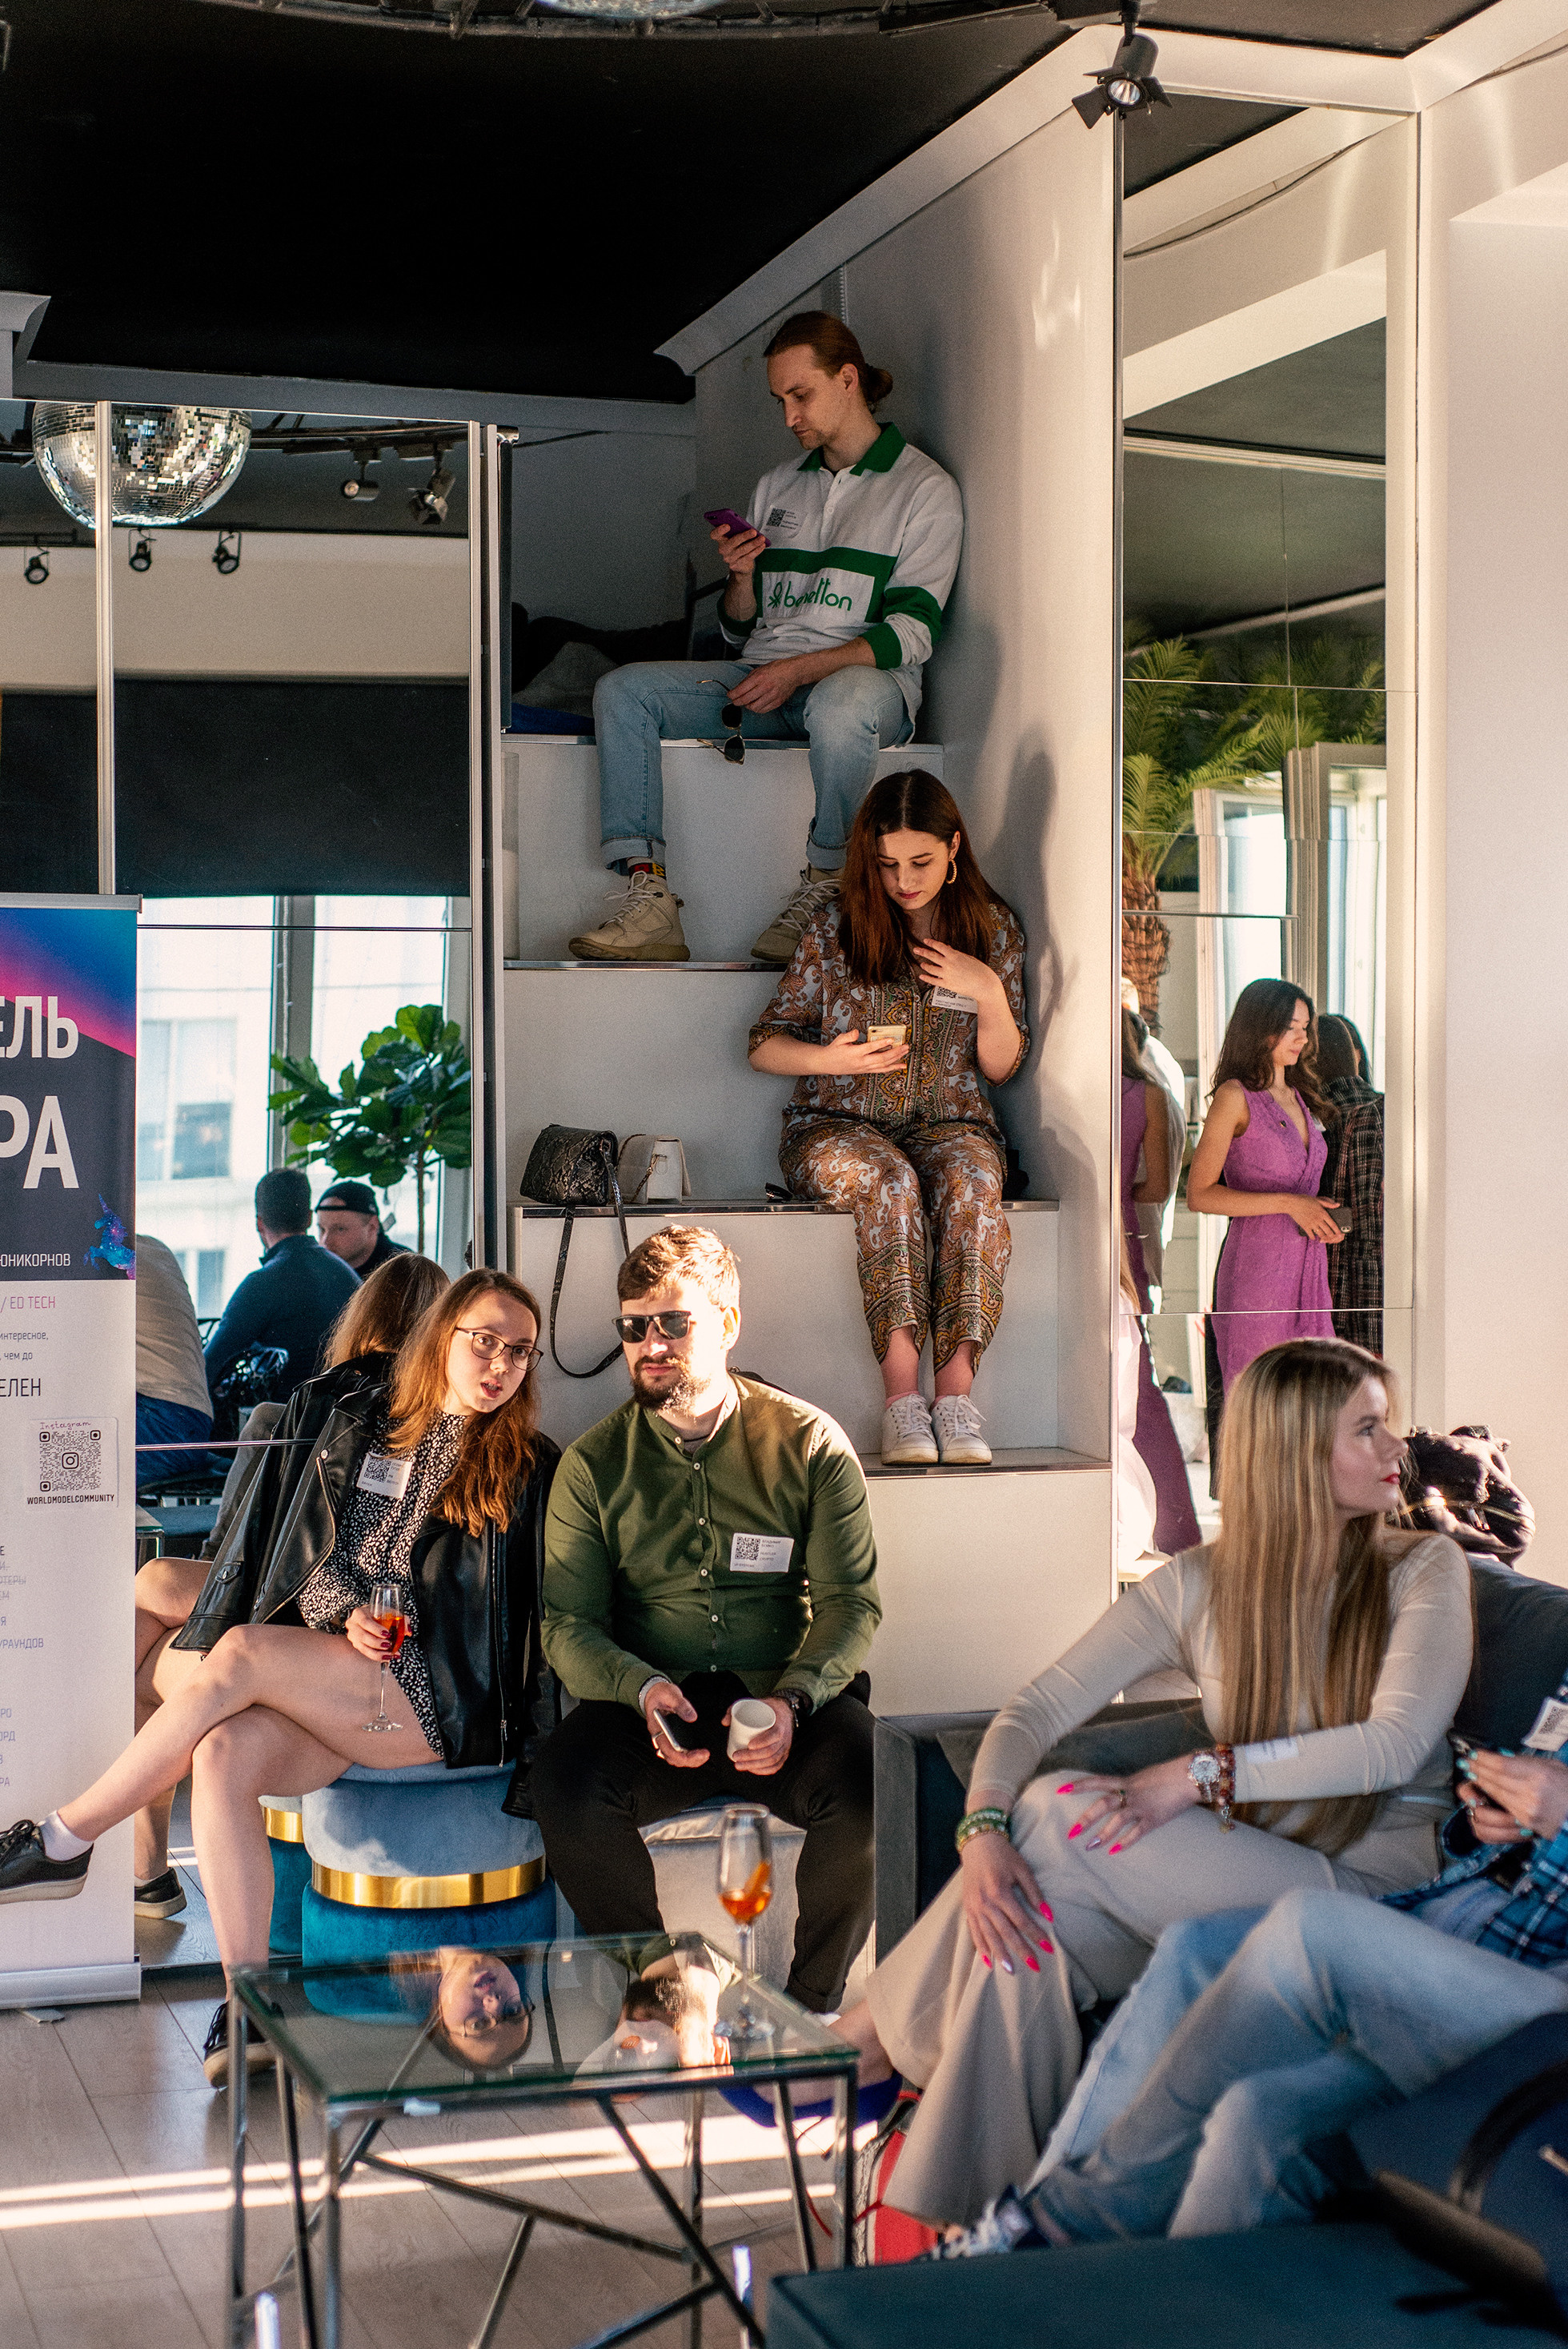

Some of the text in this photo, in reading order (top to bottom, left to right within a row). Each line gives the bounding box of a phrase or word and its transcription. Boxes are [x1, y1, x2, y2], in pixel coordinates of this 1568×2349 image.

[0, 995, 79, 1059] ЛЬ
[10, 1296, 25, 1310] ED
[27, 1295, 56, 1310] TECH
[3, 1351, 34, 1361] чем до
[39, 1420, 92, 1431] Instagram
[26, 1494, 115, 1505] WORLDMODELCOMMUNITY
